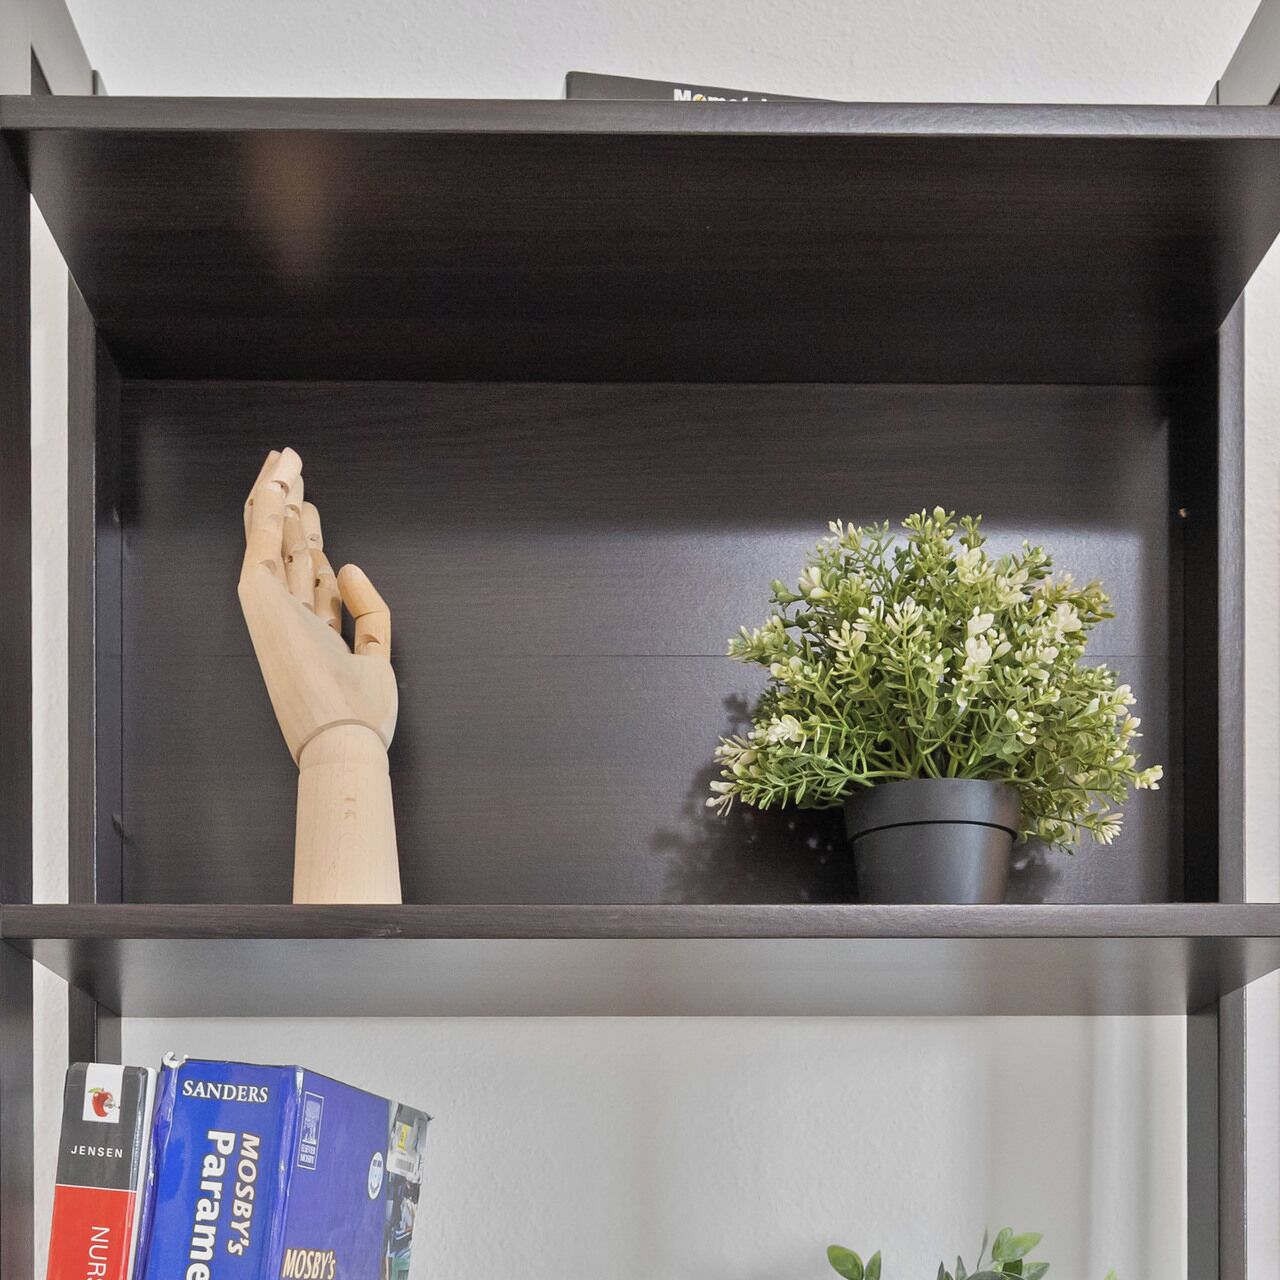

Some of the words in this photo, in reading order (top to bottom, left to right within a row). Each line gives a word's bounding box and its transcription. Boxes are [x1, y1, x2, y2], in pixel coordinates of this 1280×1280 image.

[182, 1079, 269, 1103] SANDERS
[70, 1145, 123, 1159] JENSEN
[227, 1132, 261, 1256] MOSBY's
[282, 1248, 336, 1280] MOSBY's
